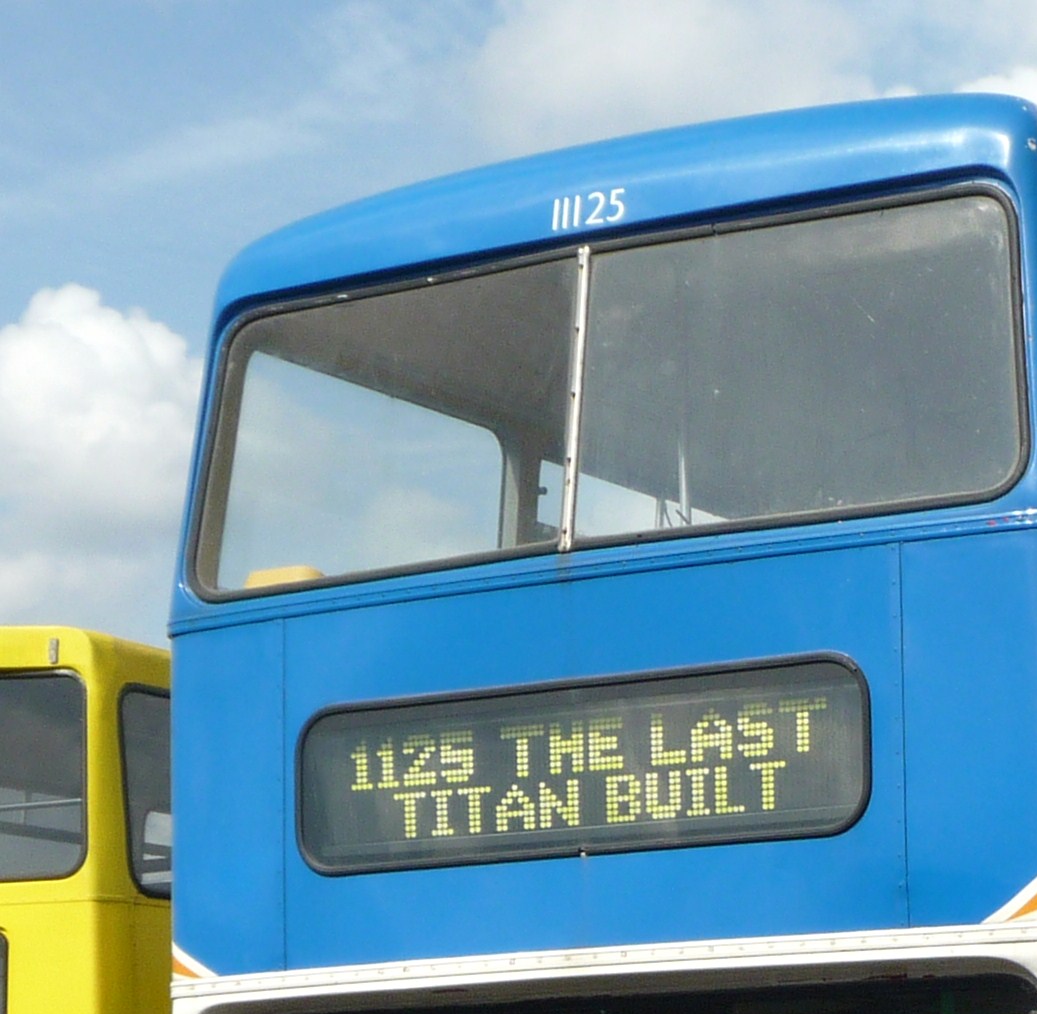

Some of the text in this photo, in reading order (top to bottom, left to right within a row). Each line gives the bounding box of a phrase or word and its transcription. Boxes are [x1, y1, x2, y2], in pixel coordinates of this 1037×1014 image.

[551, 187, 626, 232] 11125
[350, 696, 828, 791] 1125 THE LAST
[393, 760, 787, 839] TITAN BUILT
